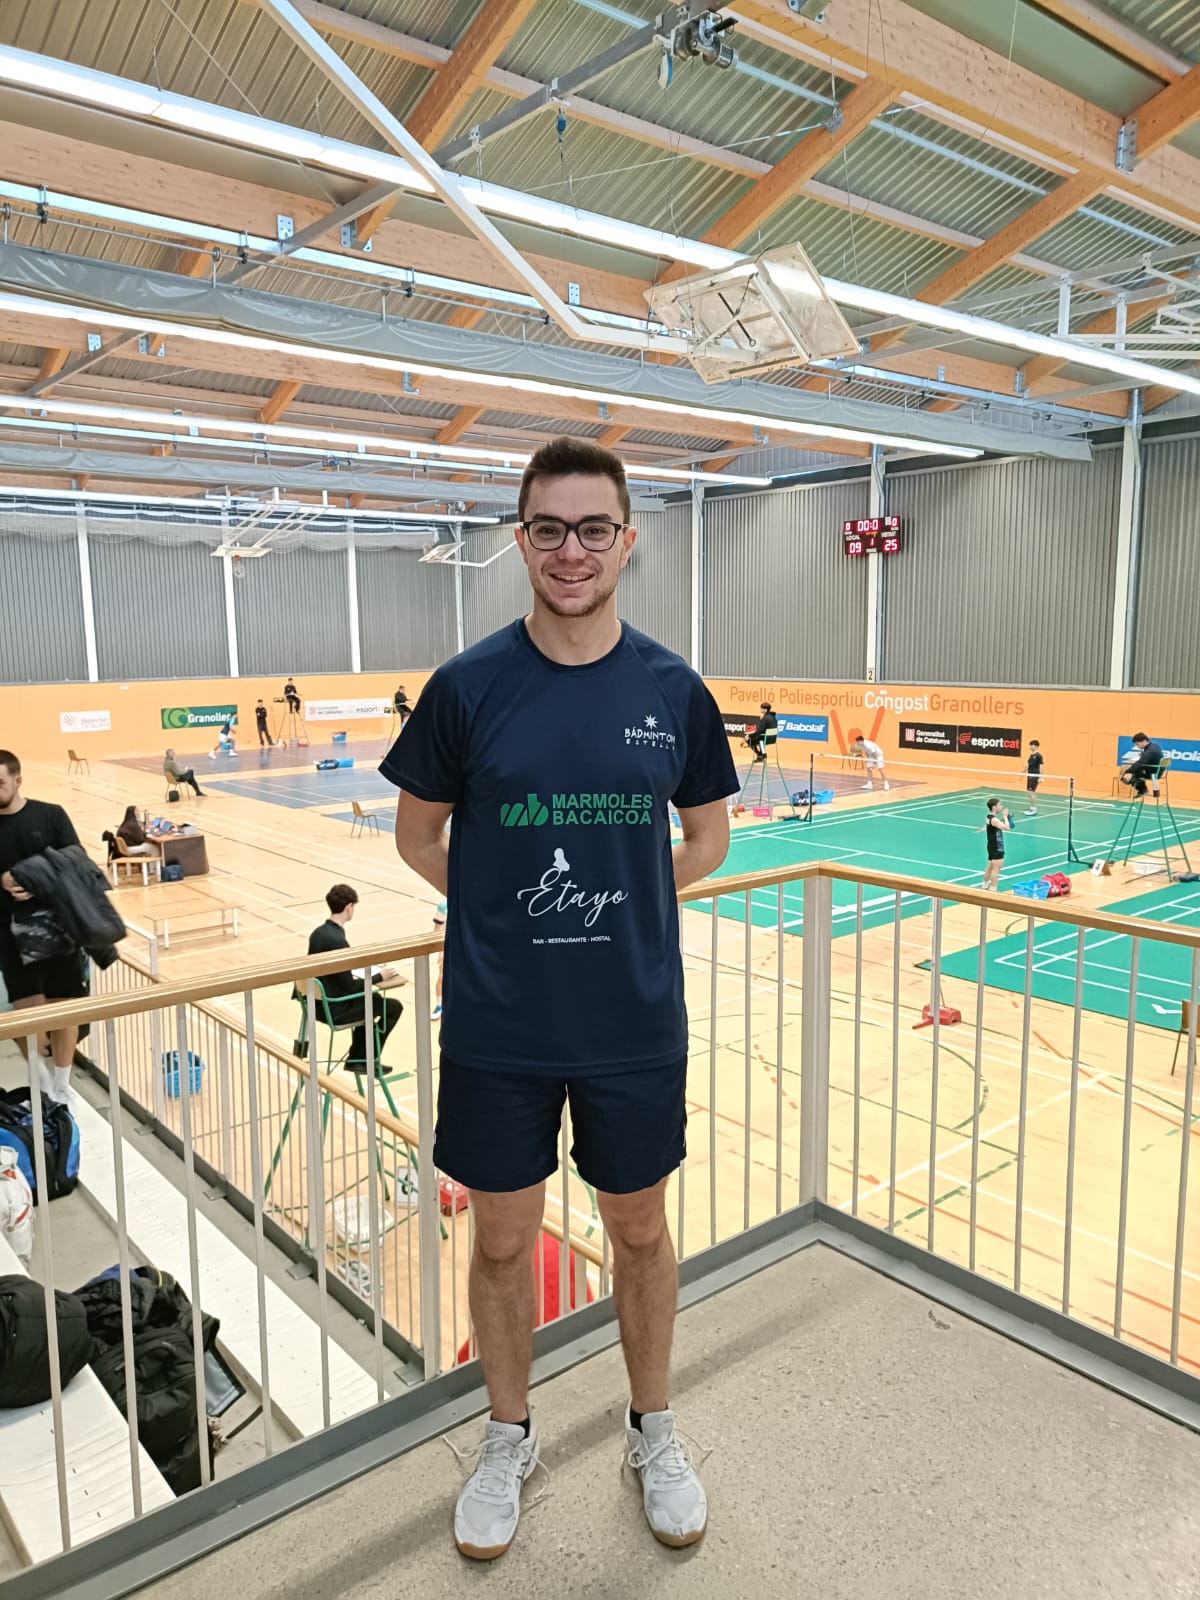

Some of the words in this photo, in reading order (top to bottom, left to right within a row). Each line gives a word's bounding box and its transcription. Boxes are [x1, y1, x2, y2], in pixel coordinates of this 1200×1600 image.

[849, 542, 862, 554] 09
[884, 539, 898, 551] 25
[868, 670, 873, 681] 2
[730, 686, 775, 703] Pavelló
[780, 688, 864, 709] Poliesportiu
[930, 693, 1024, 716] Granollers
[187, 712, 231, 723] Granoller
[786, 722, 824, 733] Babolat
[971, 737, 1020, 749] esportcat
[552, 793, 654, 809] MARMOLES
[552, 810, 652, 826] BACAICOA
[516, 867, 629, 928] Etayo
